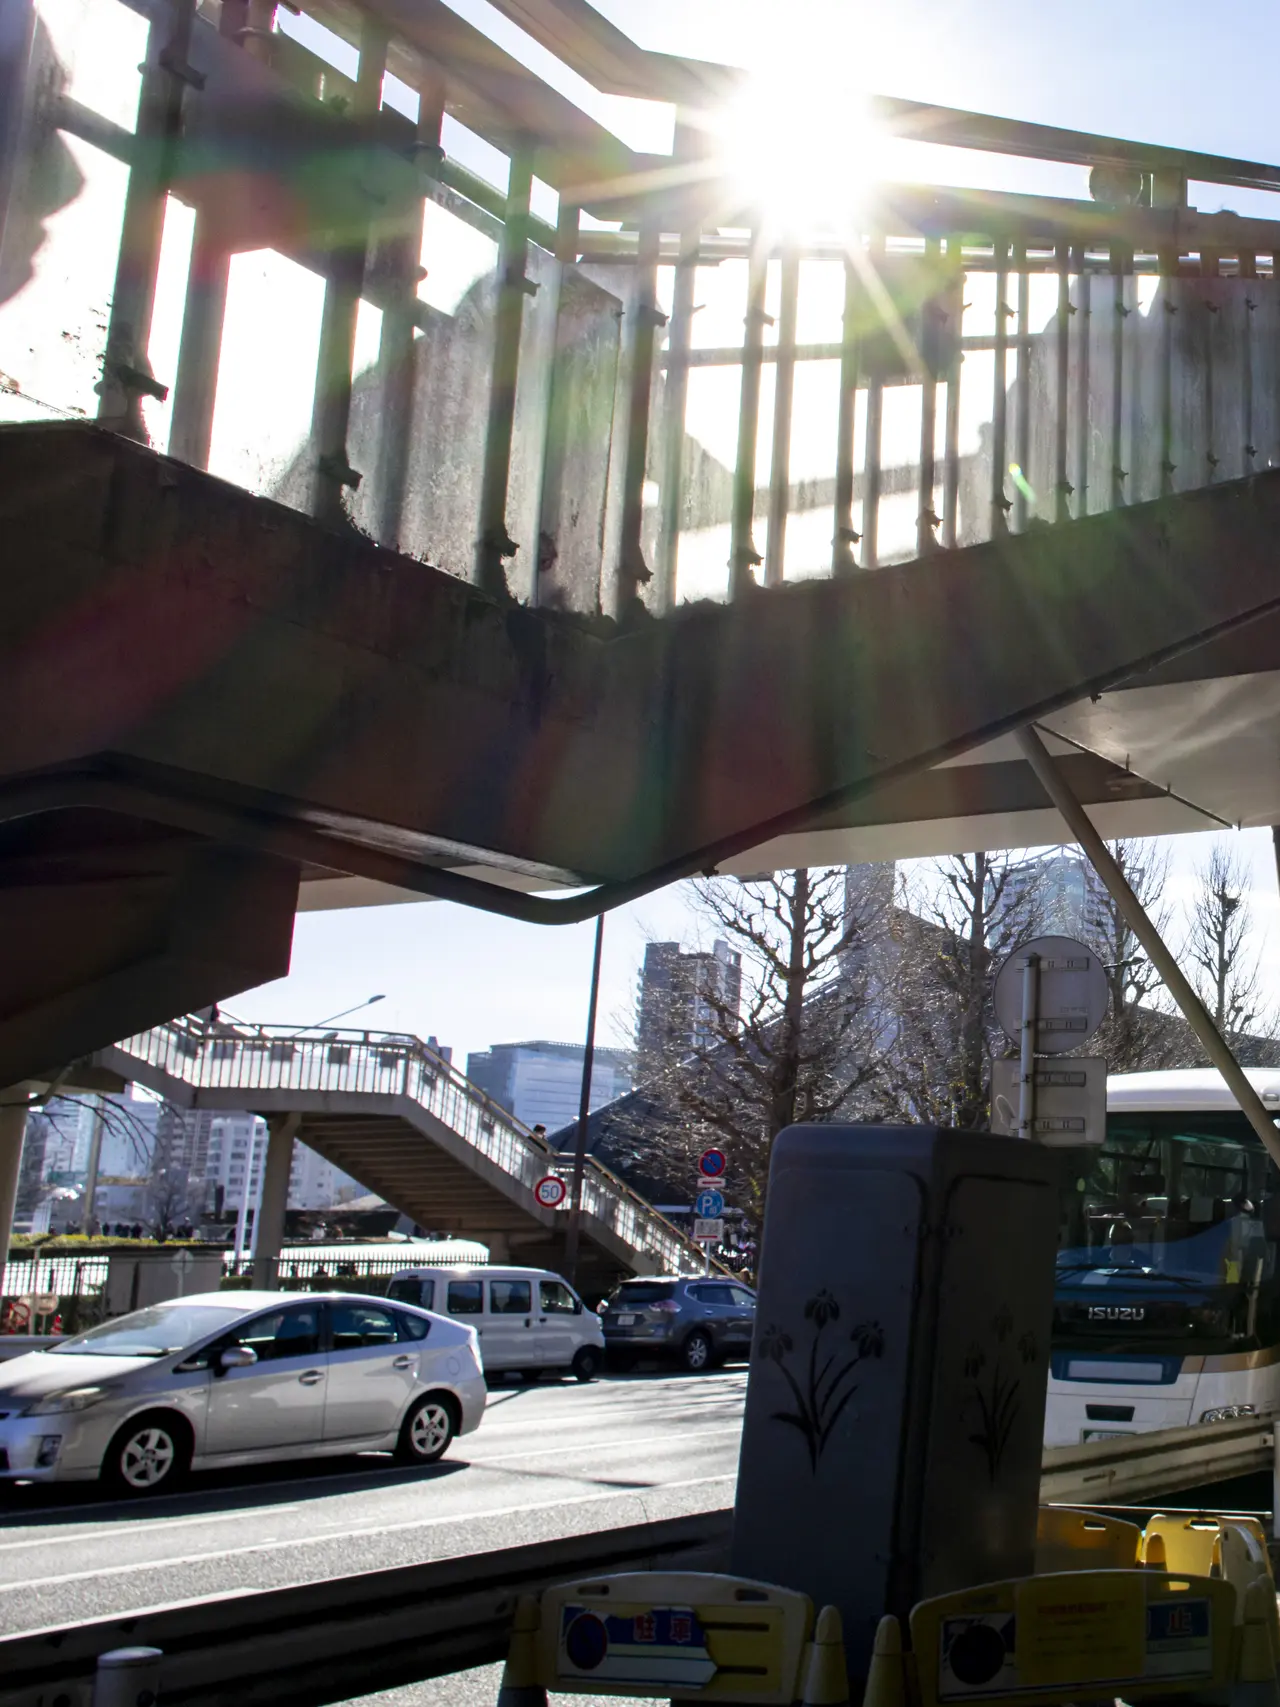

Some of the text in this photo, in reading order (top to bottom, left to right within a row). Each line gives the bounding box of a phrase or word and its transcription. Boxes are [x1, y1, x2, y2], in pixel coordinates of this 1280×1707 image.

[541, 1184, 559, 1199] 50
[701, 1195, 714, 1215] P
[1088, 1306, 1145, 1321] ISUZU
[632, 1612, 692, 1643] 駐車
